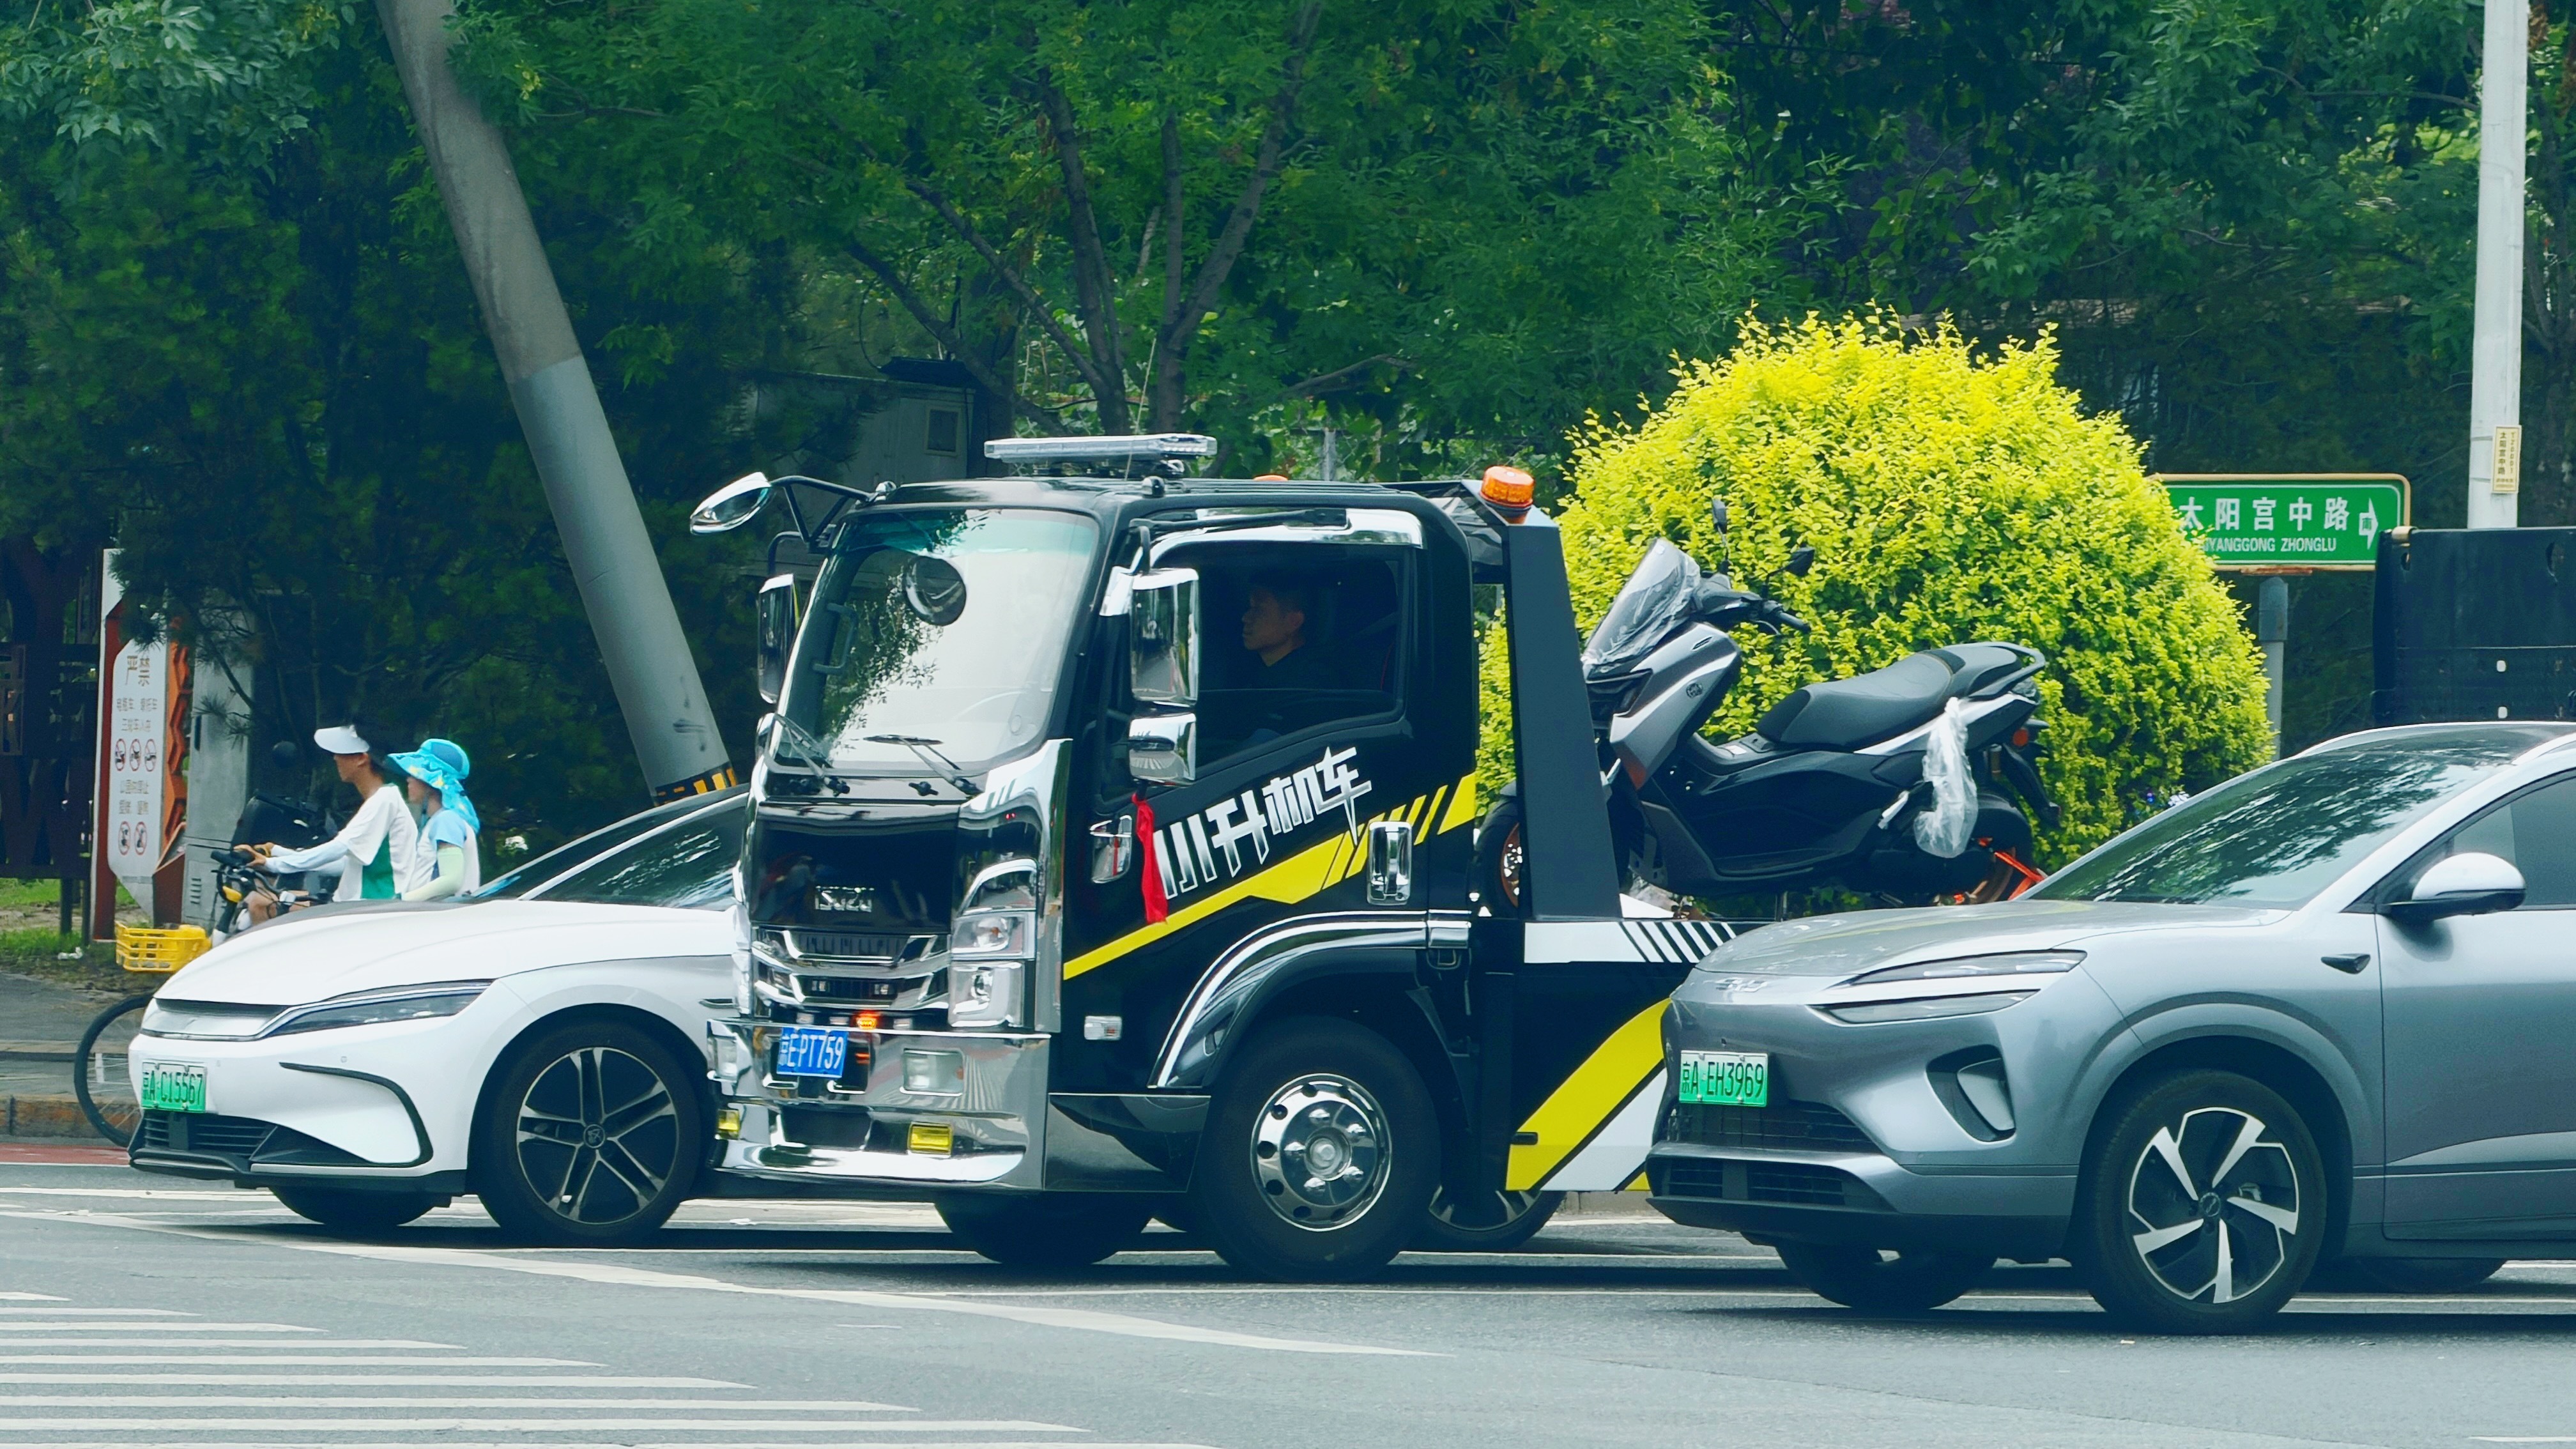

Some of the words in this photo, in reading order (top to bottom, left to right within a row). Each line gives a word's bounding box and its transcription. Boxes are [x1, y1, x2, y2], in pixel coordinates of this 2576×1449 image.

[2179, 496, 2349, 532] 太阳宫中路
[2280, 537, 2336, 552] ZHONGLU
[125, 655, 150, 687] 严禁
